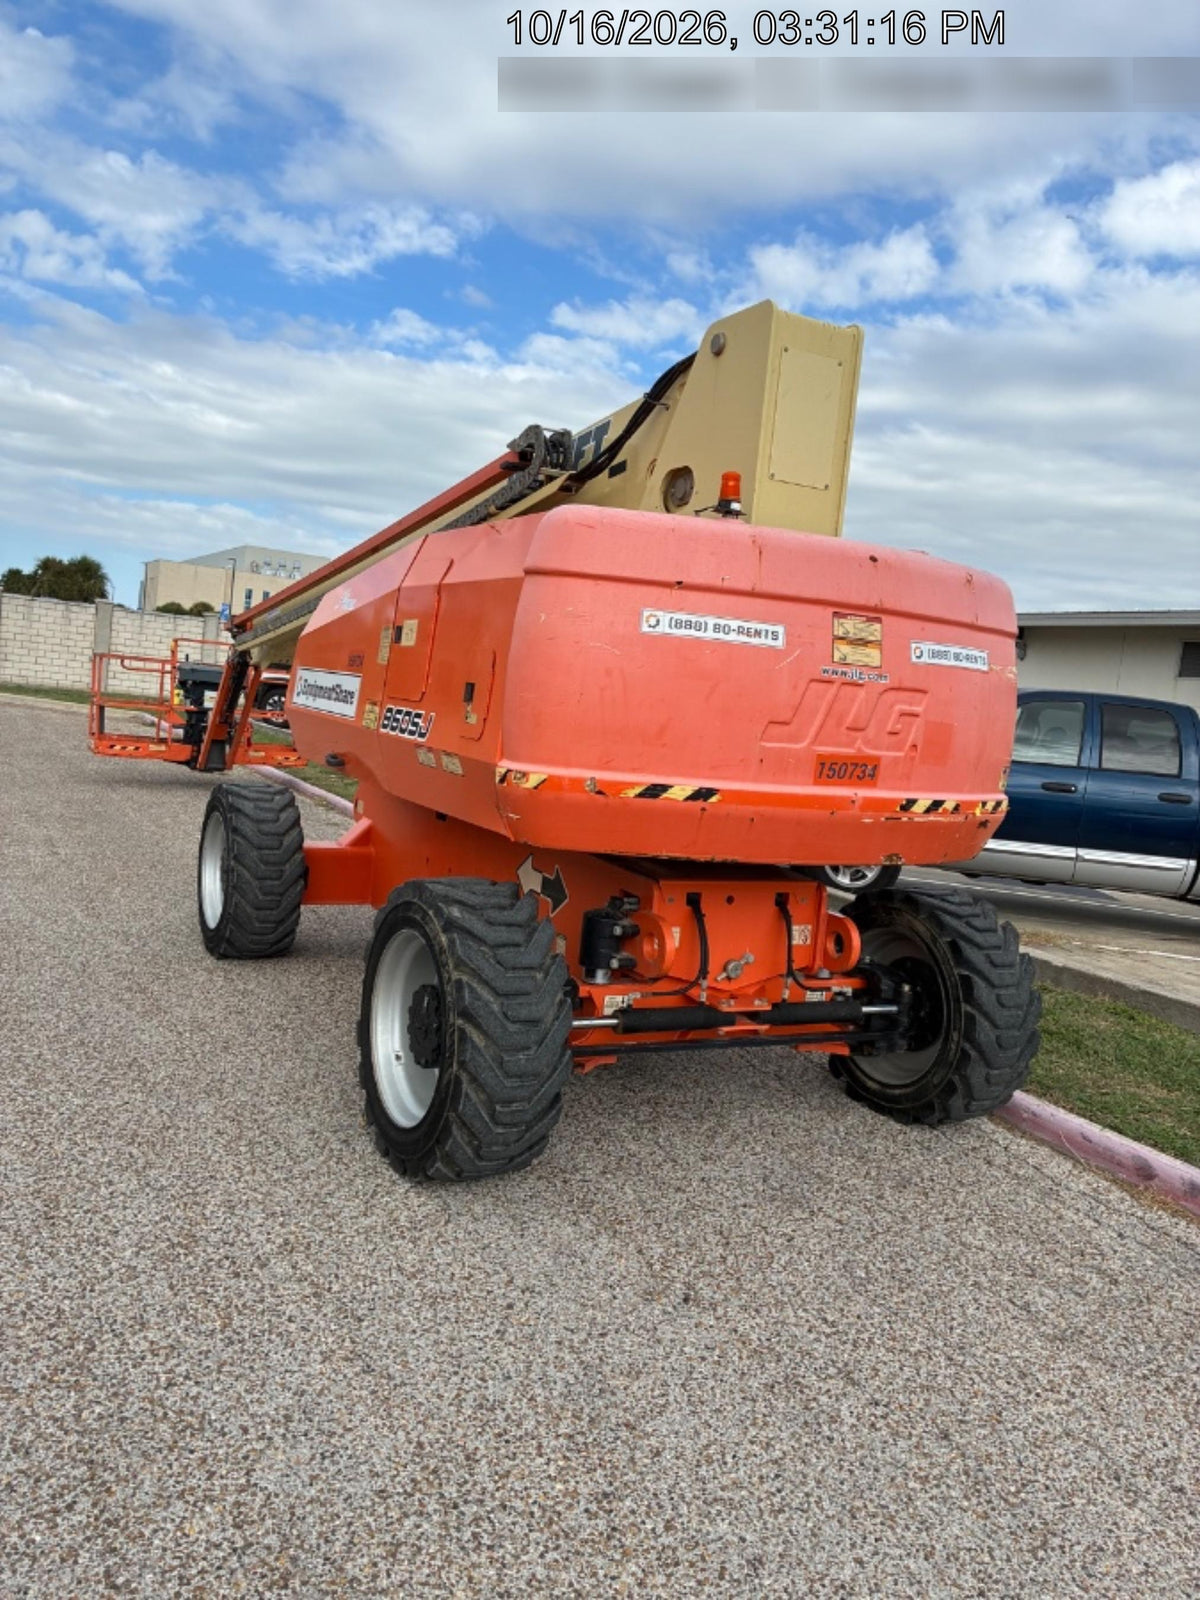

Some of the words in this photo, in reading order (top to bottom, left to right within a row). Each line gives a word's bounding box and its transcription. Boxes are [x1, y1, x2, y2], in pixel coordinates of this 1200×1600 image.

[570, 419, 611, 472] FT
[668, 616, 708, 634] (888)
[712, 622, 780, 642] 80-RENTS
[821, 667, 889, 683] www.jlg.com
[760, 678, 929, 756] JLG
[817, 761, 878, 781] 150734
